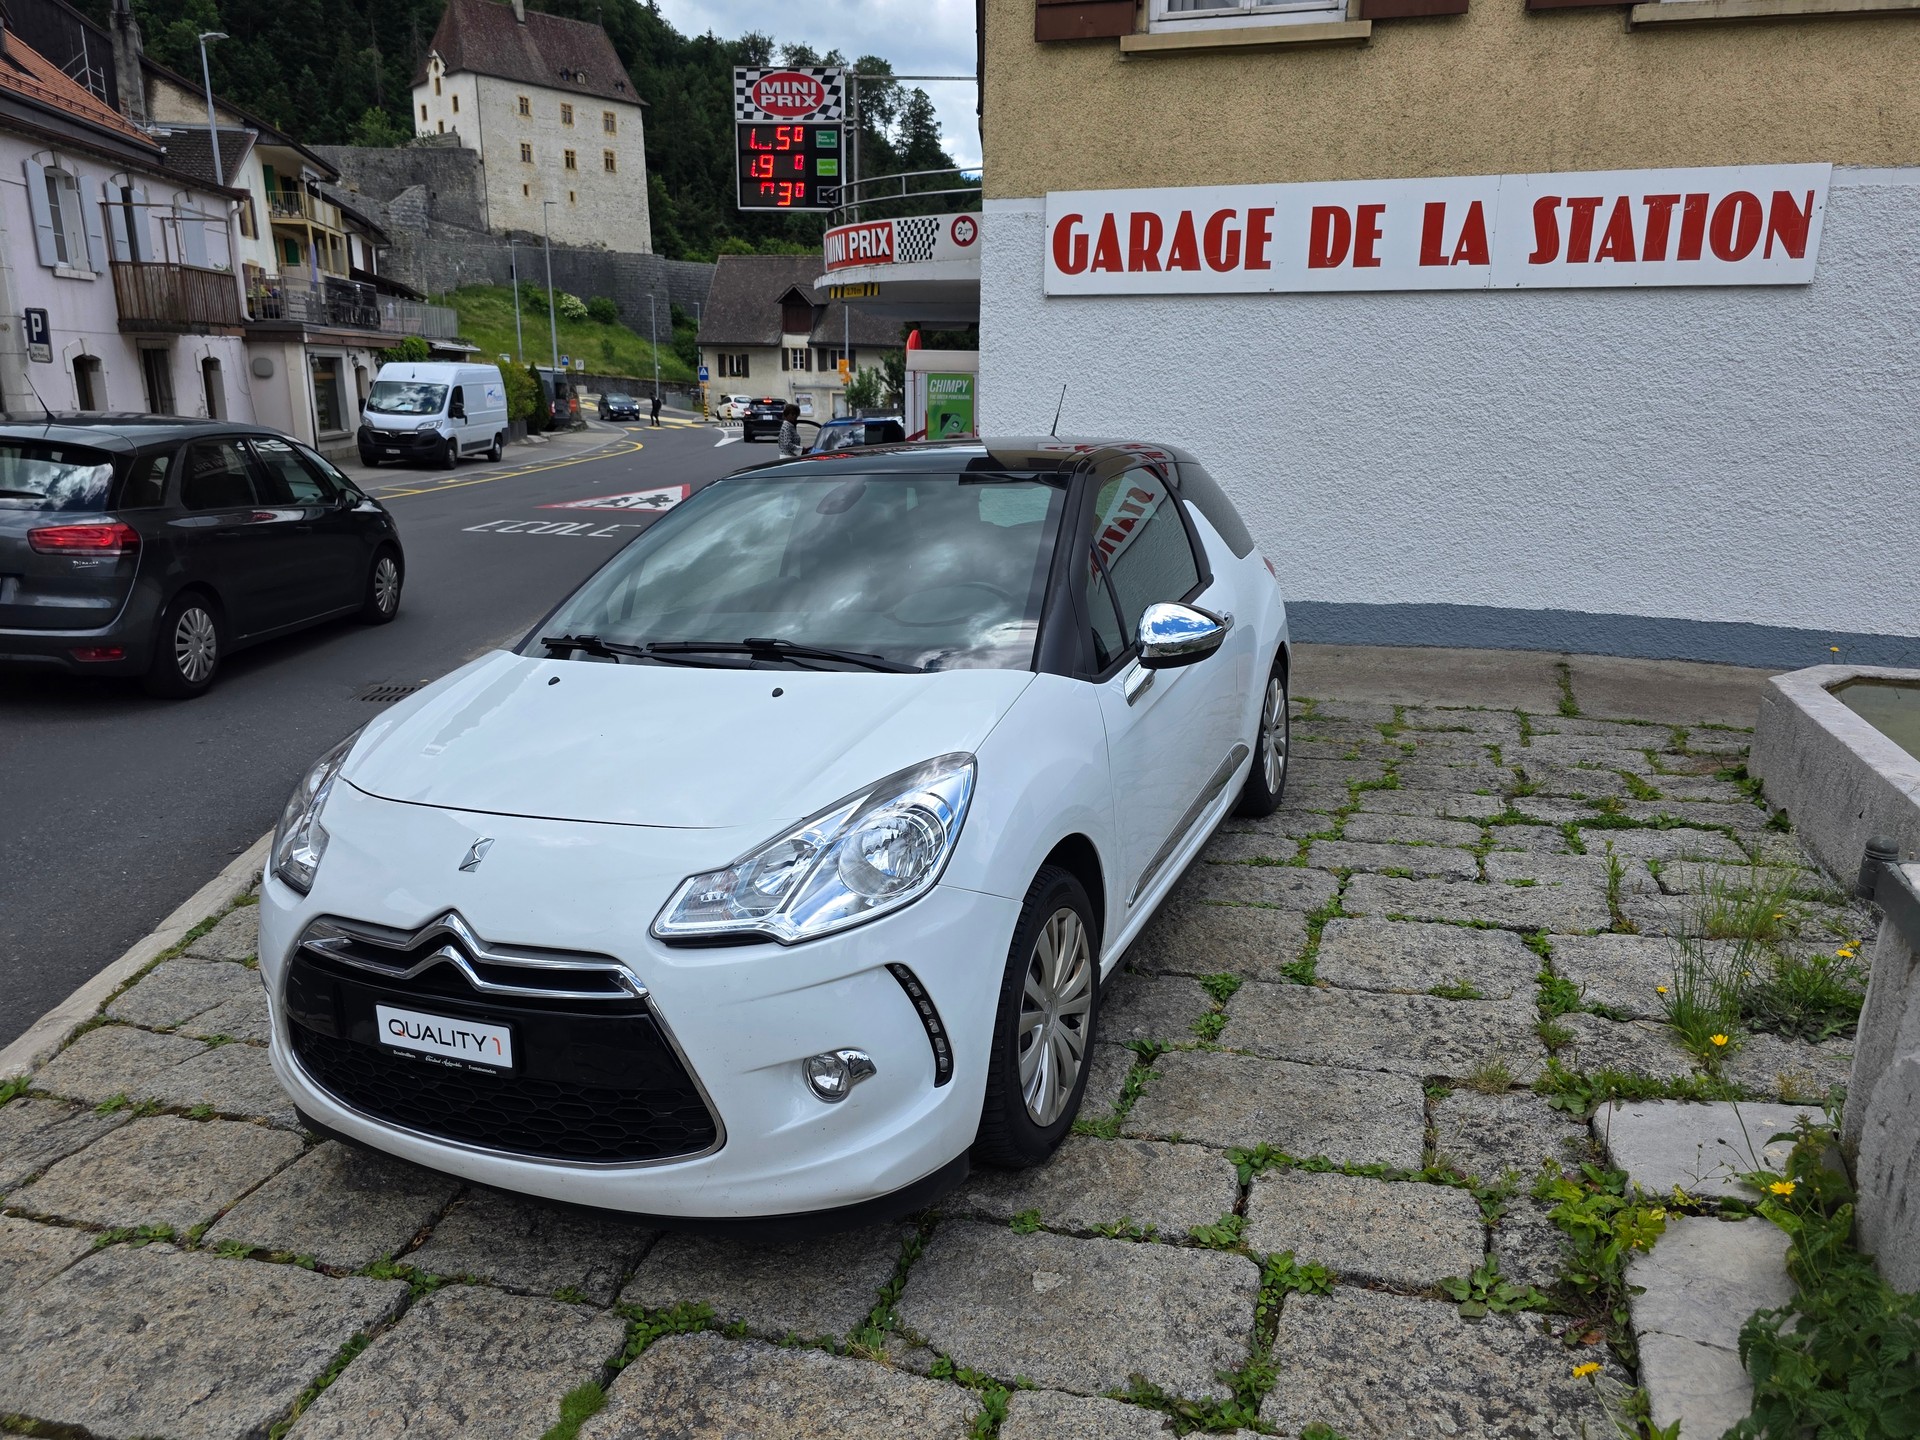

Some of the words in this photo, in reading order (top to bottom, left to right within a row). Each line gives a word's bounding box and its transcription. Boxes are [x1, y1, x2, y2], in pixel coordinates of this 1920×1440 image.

[760, 81, 817, 94] MINI
[760, 95, 818, 107] PRIX
[1052, 207, 1275, 275] GARAGE
[1308, 204, 1386, 269] DE
[1419, 200, 1490, 266] LA
[1528, 189, 1815, 265] STATION
[826, 233, 847, 265] MINI
[849, 226, 892, 261] PRIX
[31, 313, 43, 341] P
[929, 379, 969, 393] CHIMPY
[461, 519, 642, 538] ECOLE
[388, 1018, 487, 1052] QUALITY
[492, 1037, 501, 1056] 1
